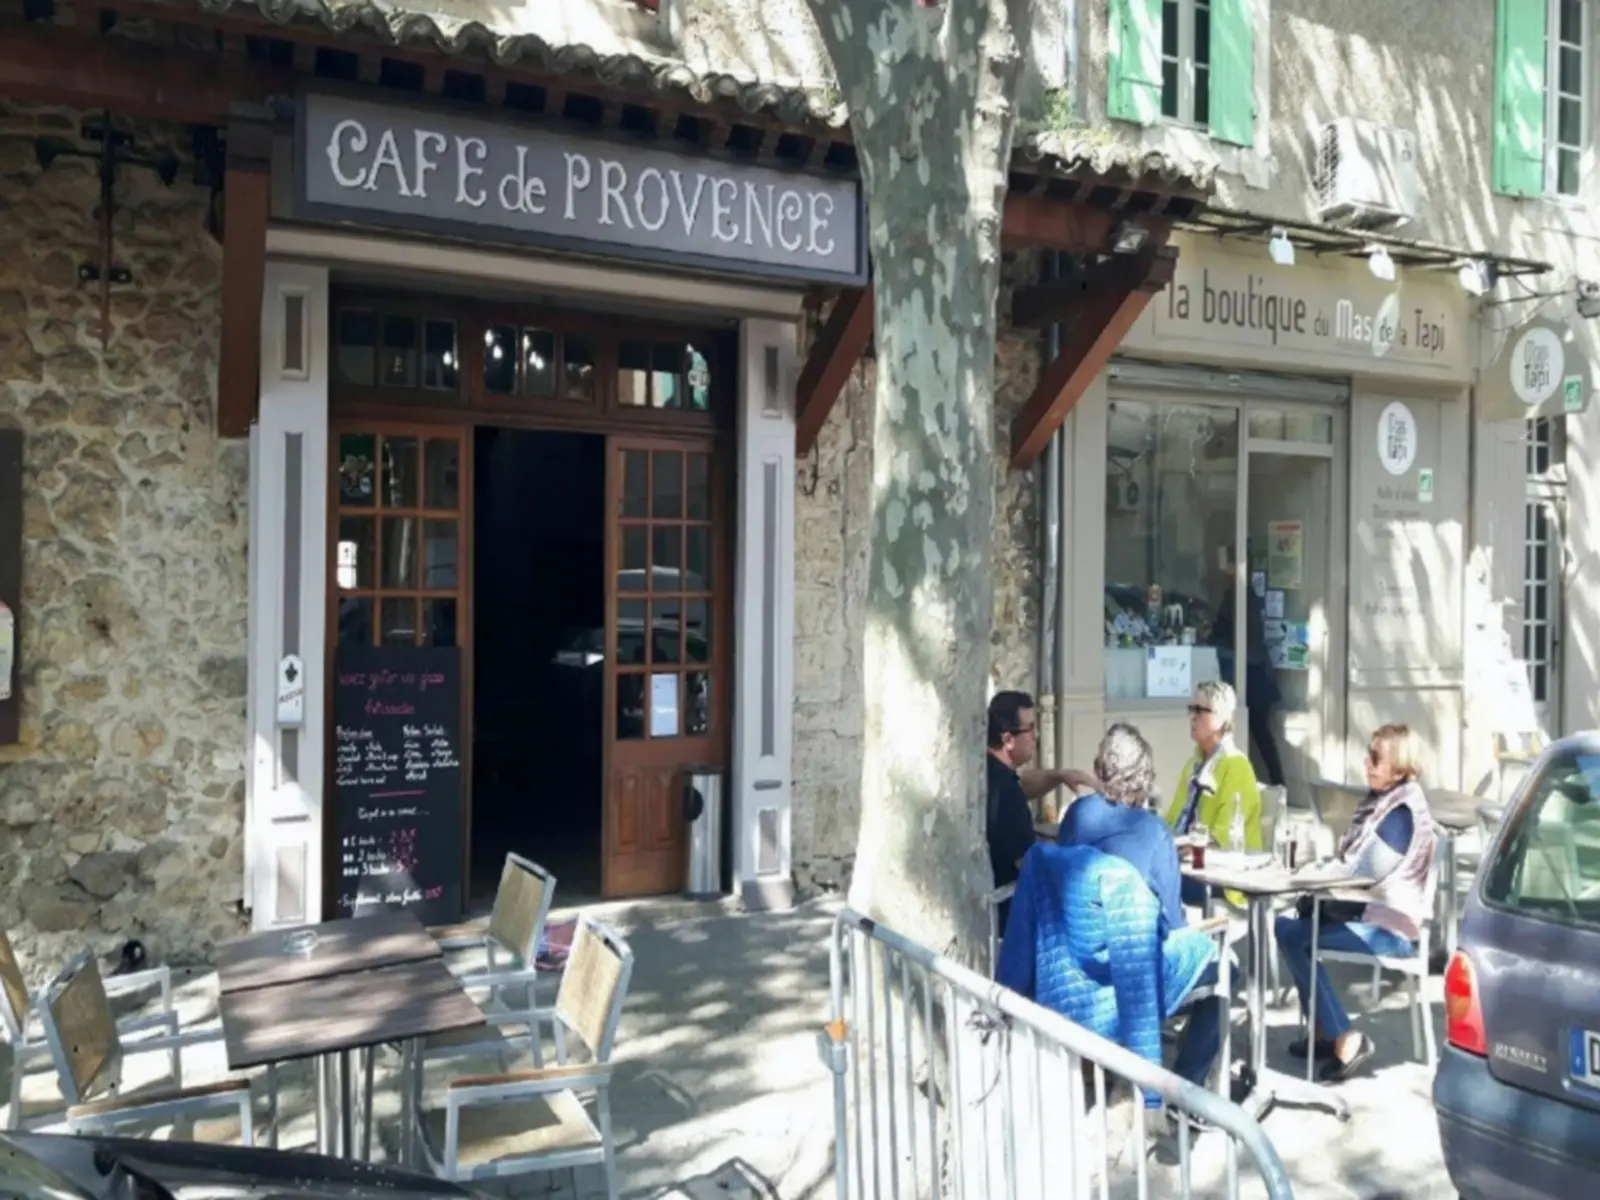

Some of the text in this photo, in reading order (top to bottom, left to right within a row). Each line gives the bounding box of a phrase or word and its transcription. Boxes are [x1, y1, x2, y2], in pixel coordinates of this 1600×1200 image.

[325, 118, 836, 256] CAFE de PROVENCE
[1168, 276, 1190, 321] la
[1202, 267, 1306, 345] boutique
[1313, 308, 1330, 337] du
[1336, 298, 1372, 342] Mas
[1414, 308, 1446, 359] Tapi
